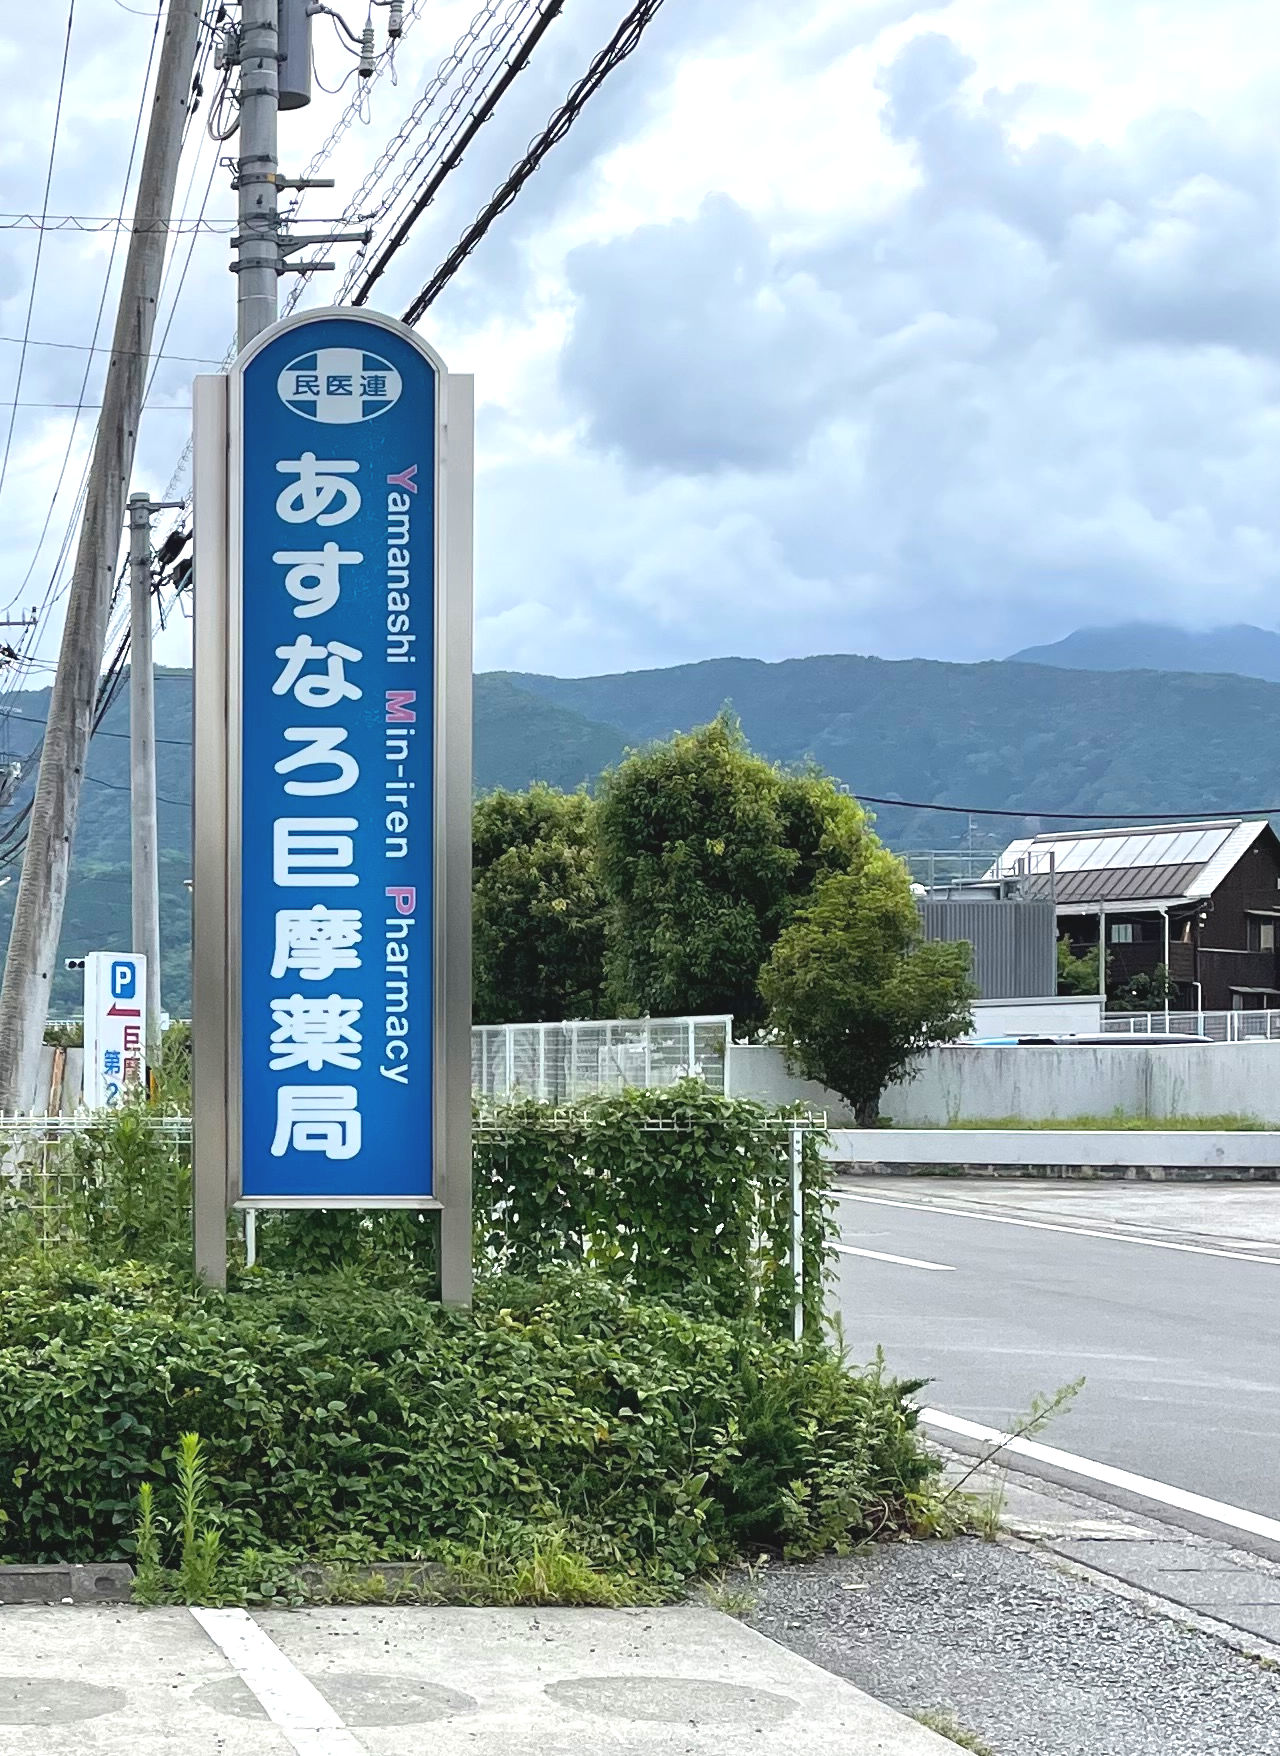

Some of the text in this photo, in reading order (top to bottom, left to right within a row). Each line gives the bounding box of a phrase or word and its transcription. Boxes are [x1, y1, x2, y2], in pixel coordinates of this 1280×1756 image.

[292, 374, 388, 398] 民医連
[269, 451, 365, 1161] あすなろ巨摩薬局
[379, 464, 418, 1085] Yamanashi Min-iren Pharmacy
[115, 965, 132, 994] P
